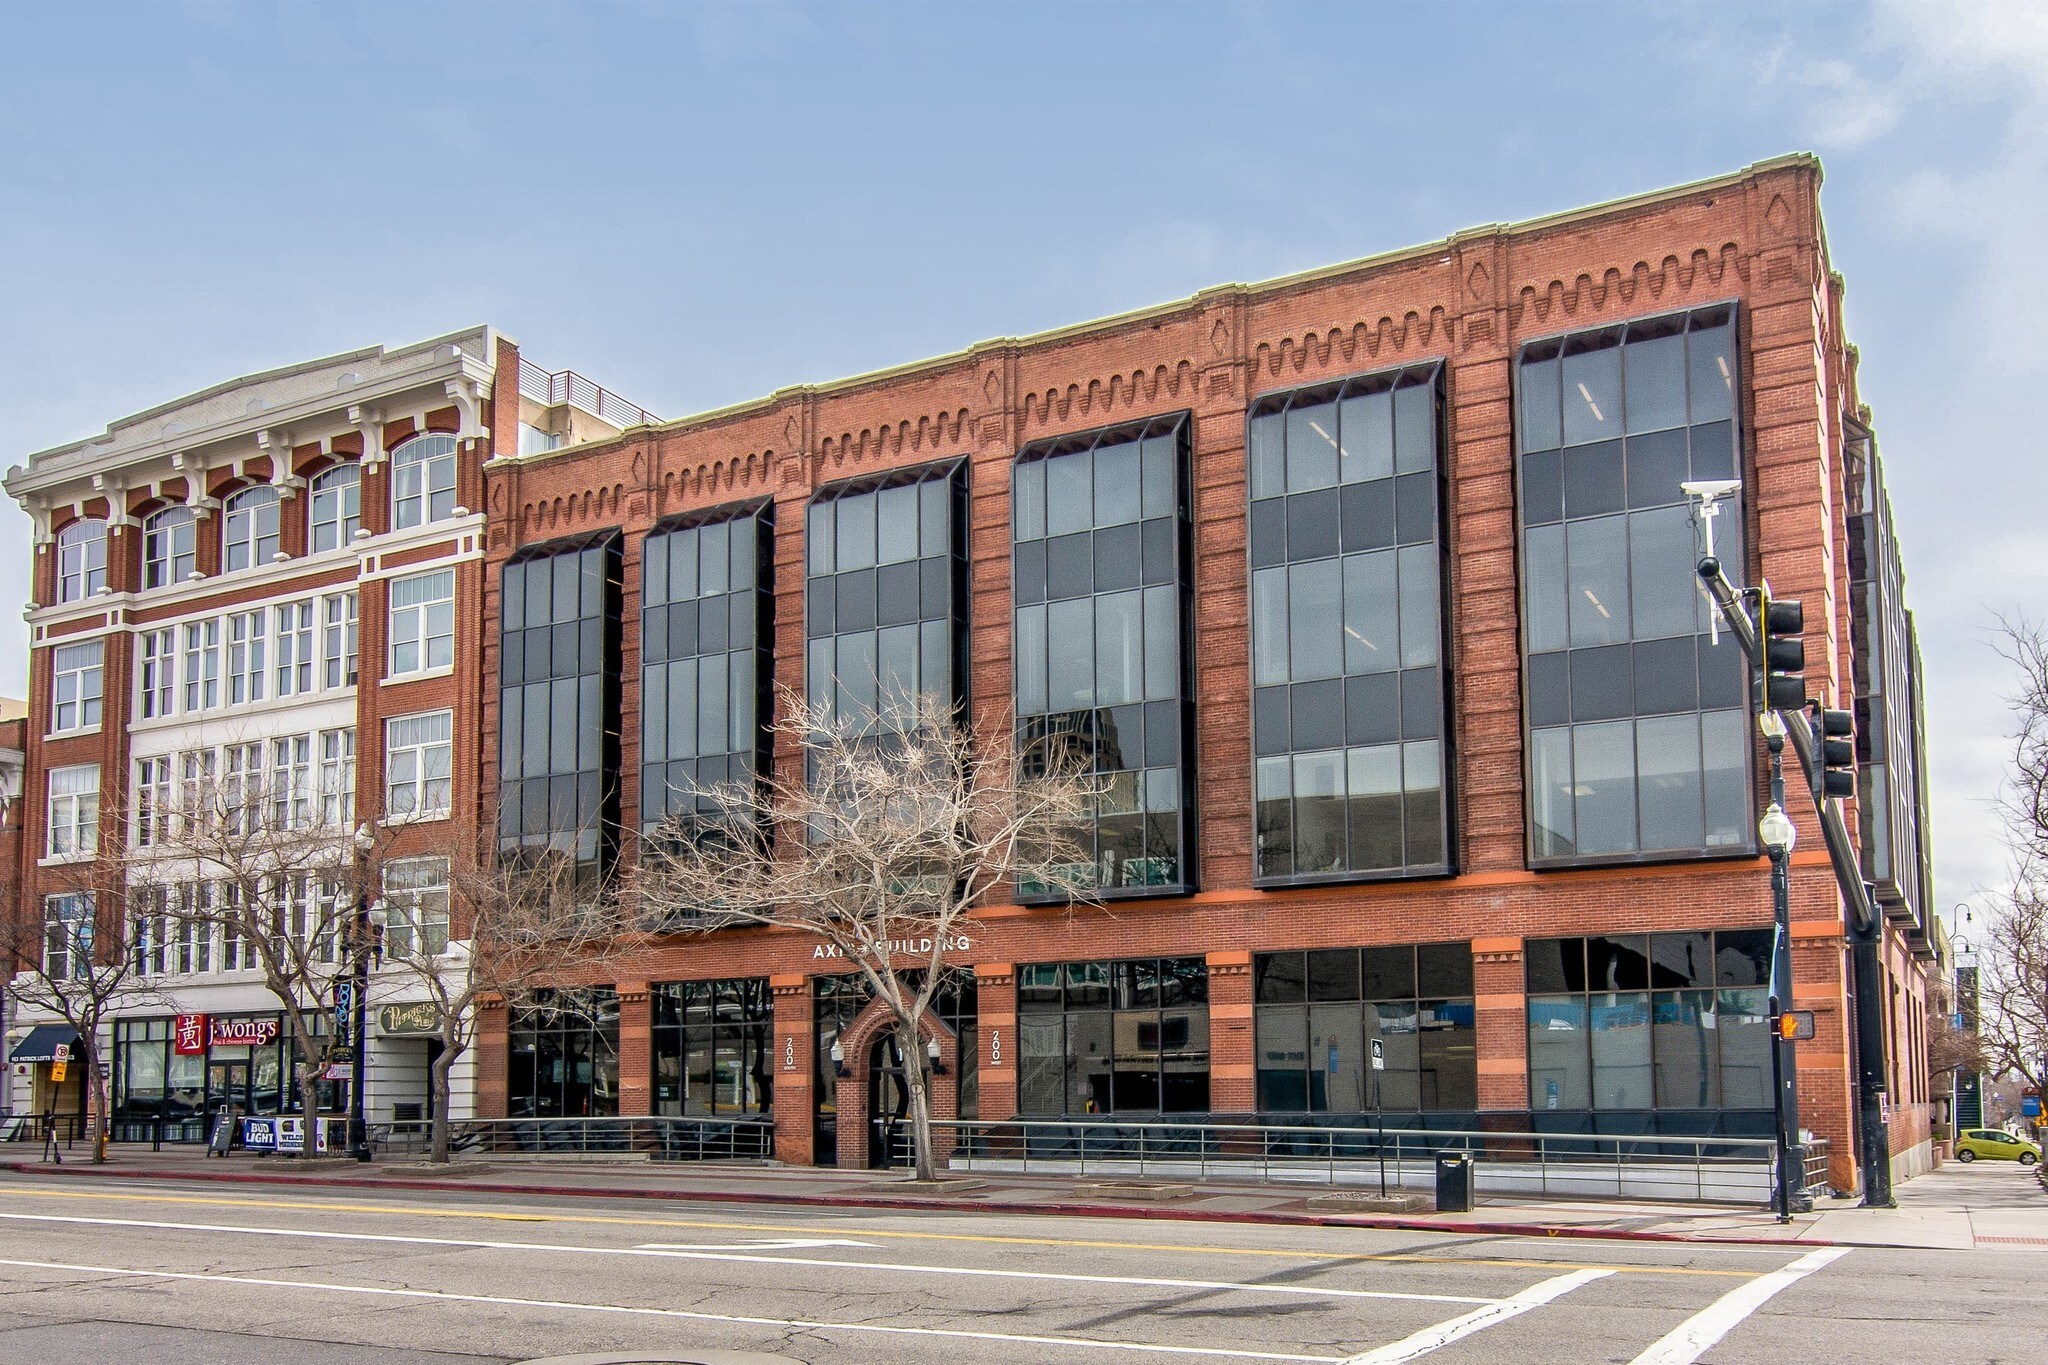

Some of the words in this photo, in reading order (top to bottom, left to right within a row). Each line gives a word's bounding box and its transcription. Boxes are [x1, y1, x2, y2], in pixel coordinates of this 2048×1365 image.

[813, 943, 857, 959] AXI
[875, 936, 970, 955] BUILDNG
[786, 1037, 794, 1065] 200
[991, 1030, 1000, 1060] 200
[245, 1132, 274, 1144] LIGHT
[250, 1122, 270, 1133] BUD
